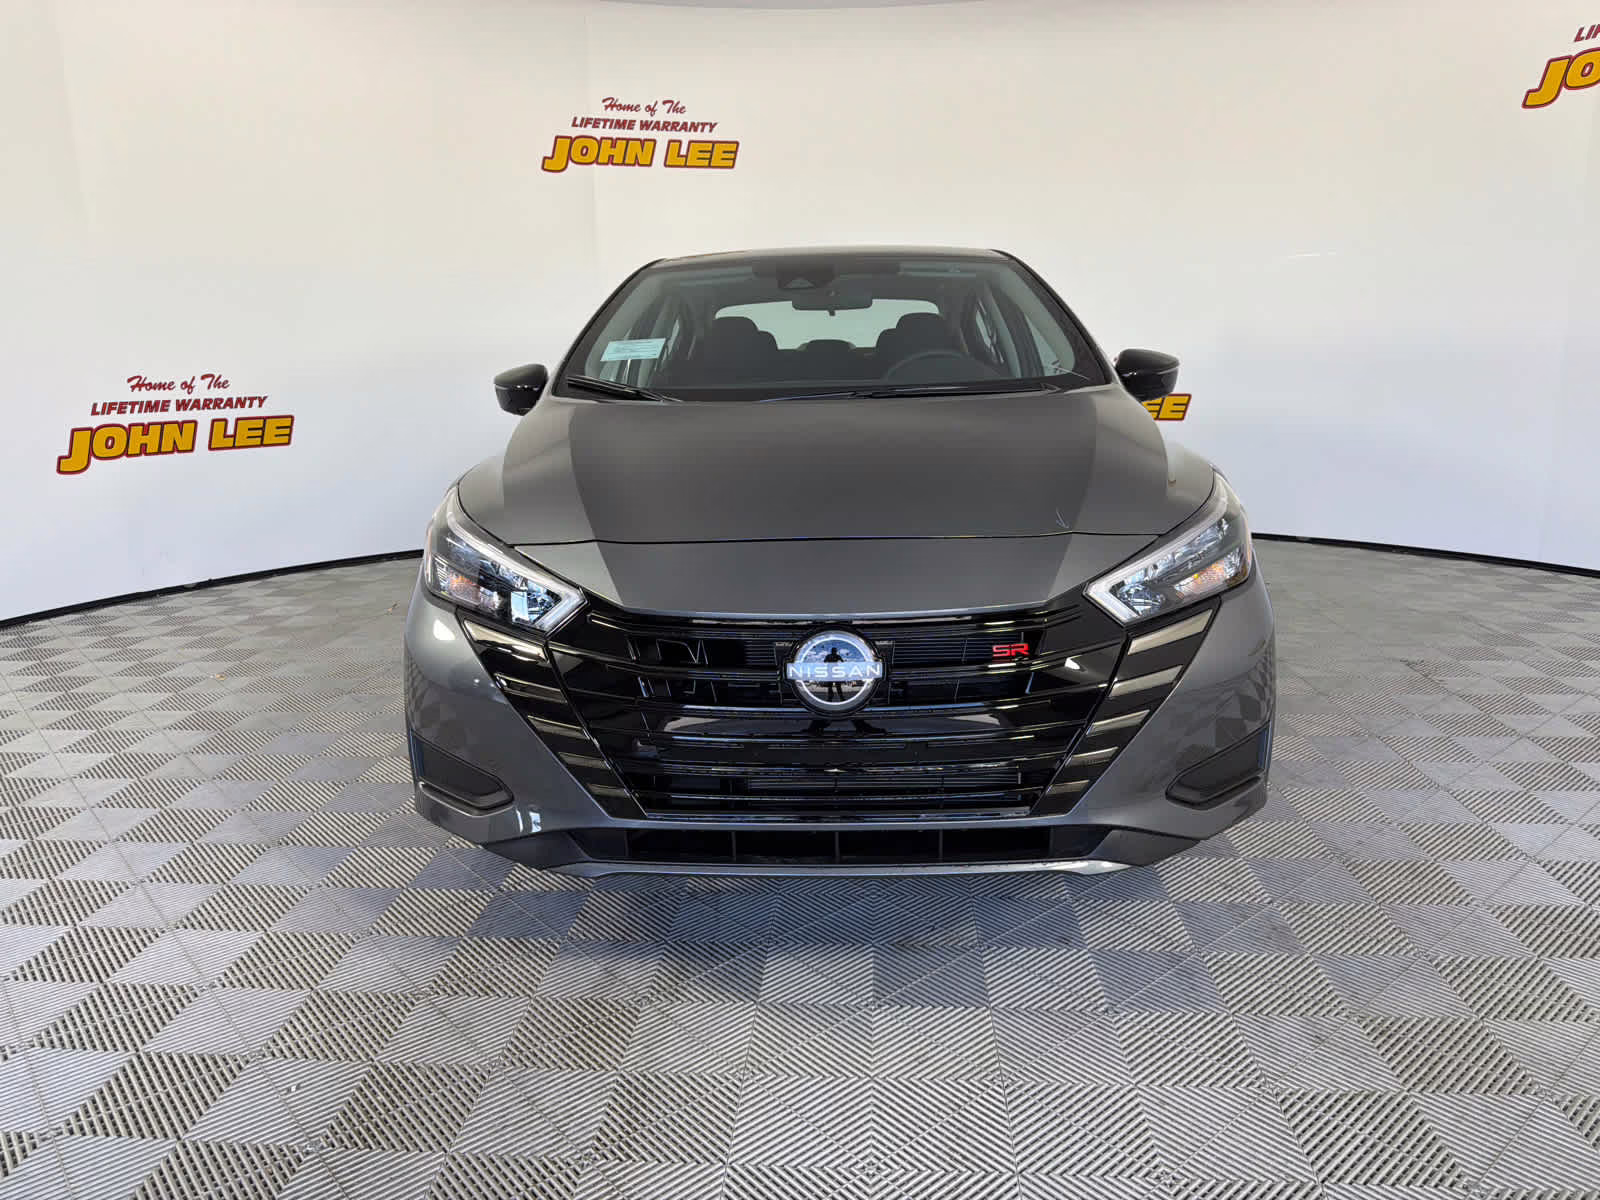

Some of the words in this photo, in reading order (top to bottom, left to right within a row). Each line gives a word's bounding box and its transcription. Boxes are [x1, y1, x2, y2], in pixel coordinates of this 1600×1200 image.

[602, 97, 641, 111] Home
[645, 100, 658, 117] of
[662, 100, 686, 115] The
[571, 117, 636, 130] LIFETIME
[639, 120, 718, 133] WARRANTY
[541, 135, 657, 173] JOHN
[663, 139, 740, 169] LEE
[127, 375, 176, 392] Home
[180, 376, 195, 394] of
[200, 373, 230, 390] The
[91, 399, 171, 416] LIFETIME
[175, 396, 268, 412] WARRANTY
[56, 420, 198, 475] JOHN
[208, 415, 294, 451] LEE
[992, 643, 1029, 657] SR
[788, 662, 881, 680] NISSAN
